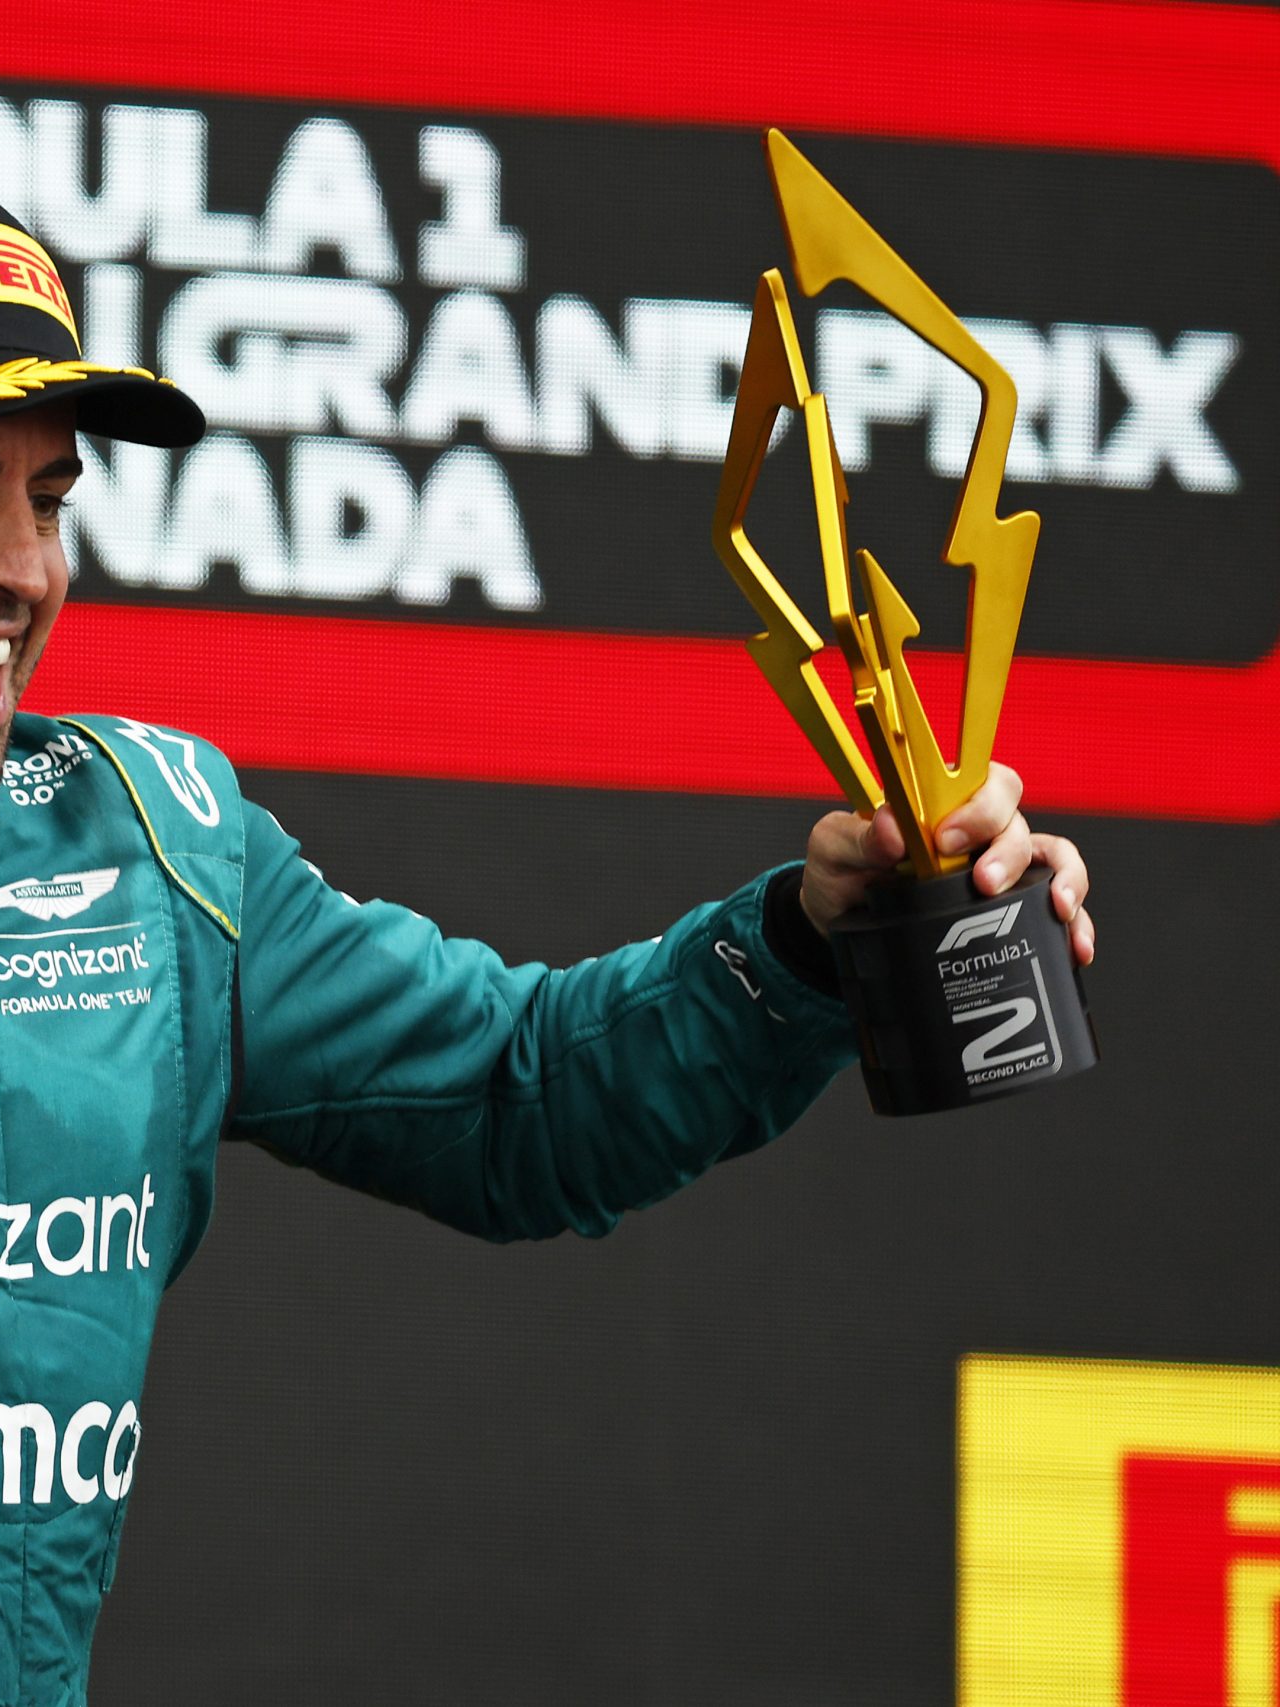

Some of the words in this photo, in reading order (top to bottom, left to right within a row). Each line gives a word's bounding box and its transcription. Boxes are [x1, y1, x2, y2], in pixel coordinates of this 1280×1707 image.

[418, 124, 526, 292] 1
[816, 308, 1241, 493] PRIX
[56, 428, 544, 612] NADA
[2, 734, 89, 779] RONI
[22, 751, 93, 786] AZZURRO
[15, 885, 47, 898] ASTON
[46, 883, 81, 897] MARTIN
[1, 993, 78, 1016] FORMULA
[952, 997, 1046, 1073] 2
[967, 1064, 1015, 1085] SECOND
[1015, 1054, 1049, 1075] PLACE
